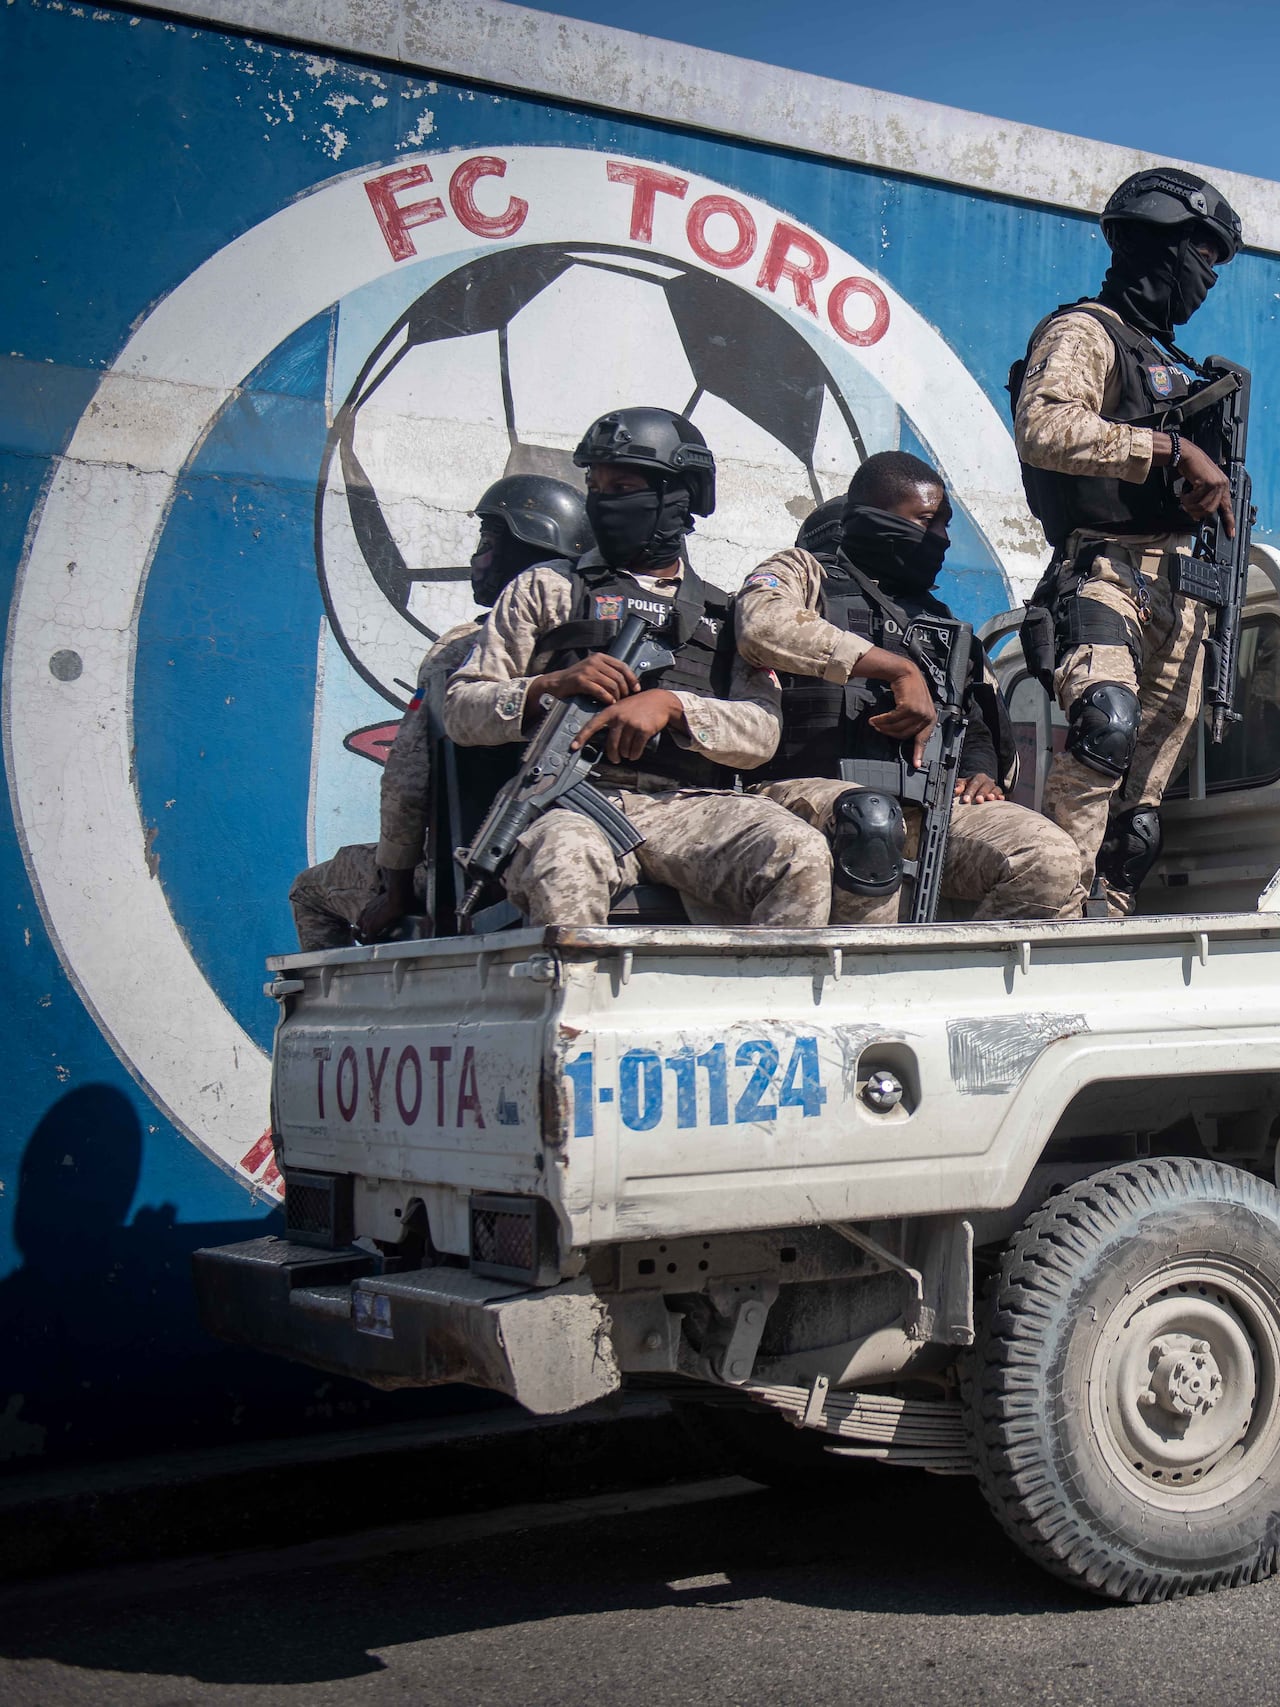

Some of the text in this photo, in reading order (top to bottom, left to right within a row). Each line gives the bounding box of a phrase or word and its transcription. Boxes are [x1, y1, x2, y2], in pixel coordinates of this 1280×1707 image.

[364, 155, 891, 347] FC TORO
[627, 598, 666, 614] POLICE
[313, 1044, 486, 1129] TOYOTA
[564, 1036, 827, 1138] 1-01124
